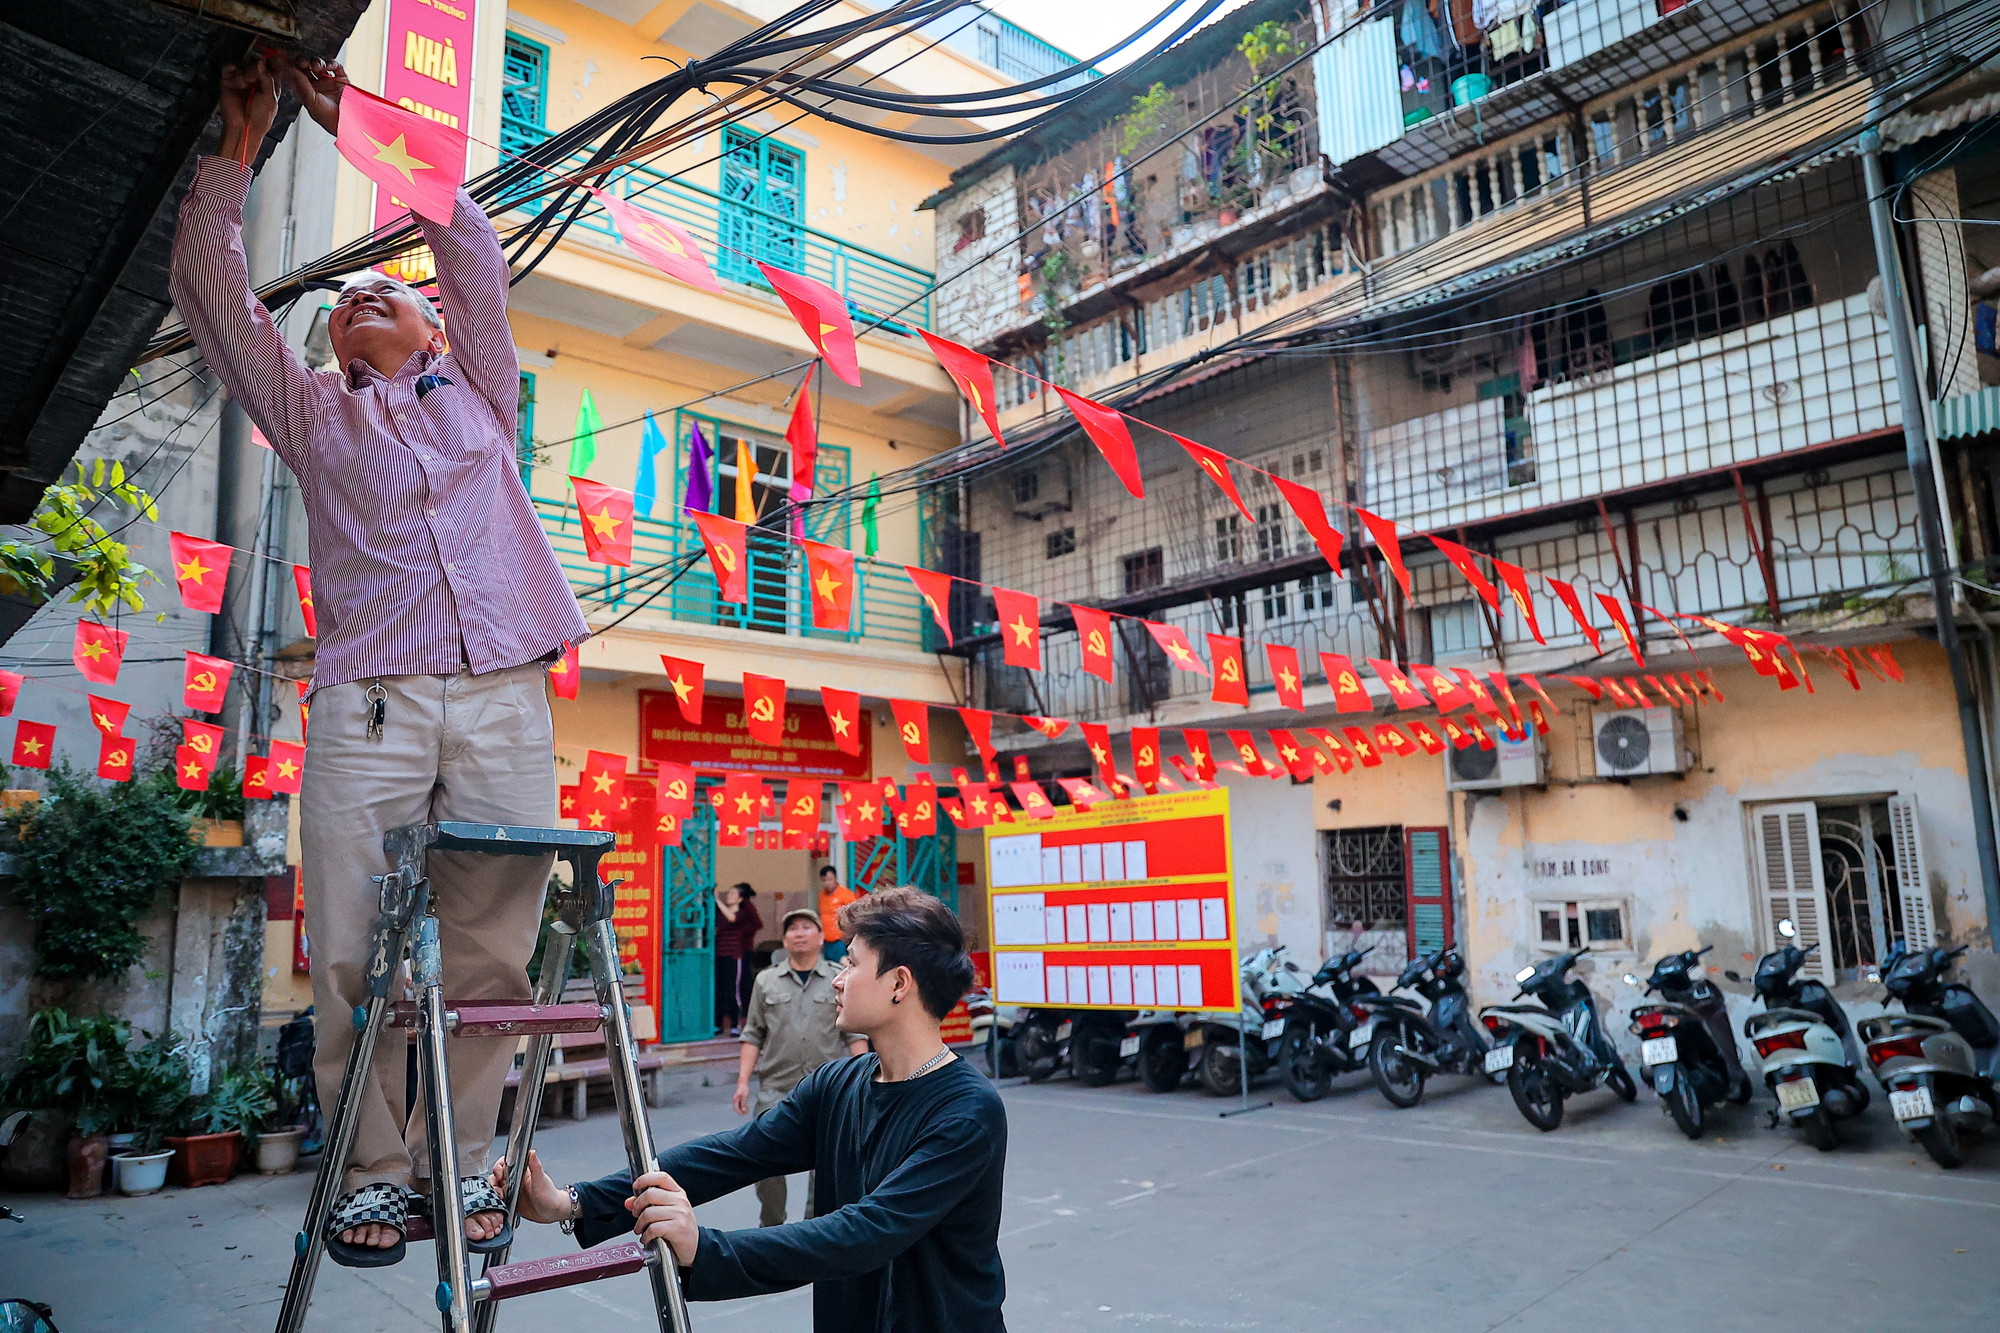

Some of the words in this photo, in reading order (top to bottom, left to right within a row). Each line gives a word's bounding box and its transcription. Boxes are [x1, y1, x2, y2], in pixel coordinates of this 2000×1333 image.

[403, 29, 459, 88] NHÀ
[461, 1179, 487, 1194] NIKE
[351, 1190, 388, 1206] NIKE
